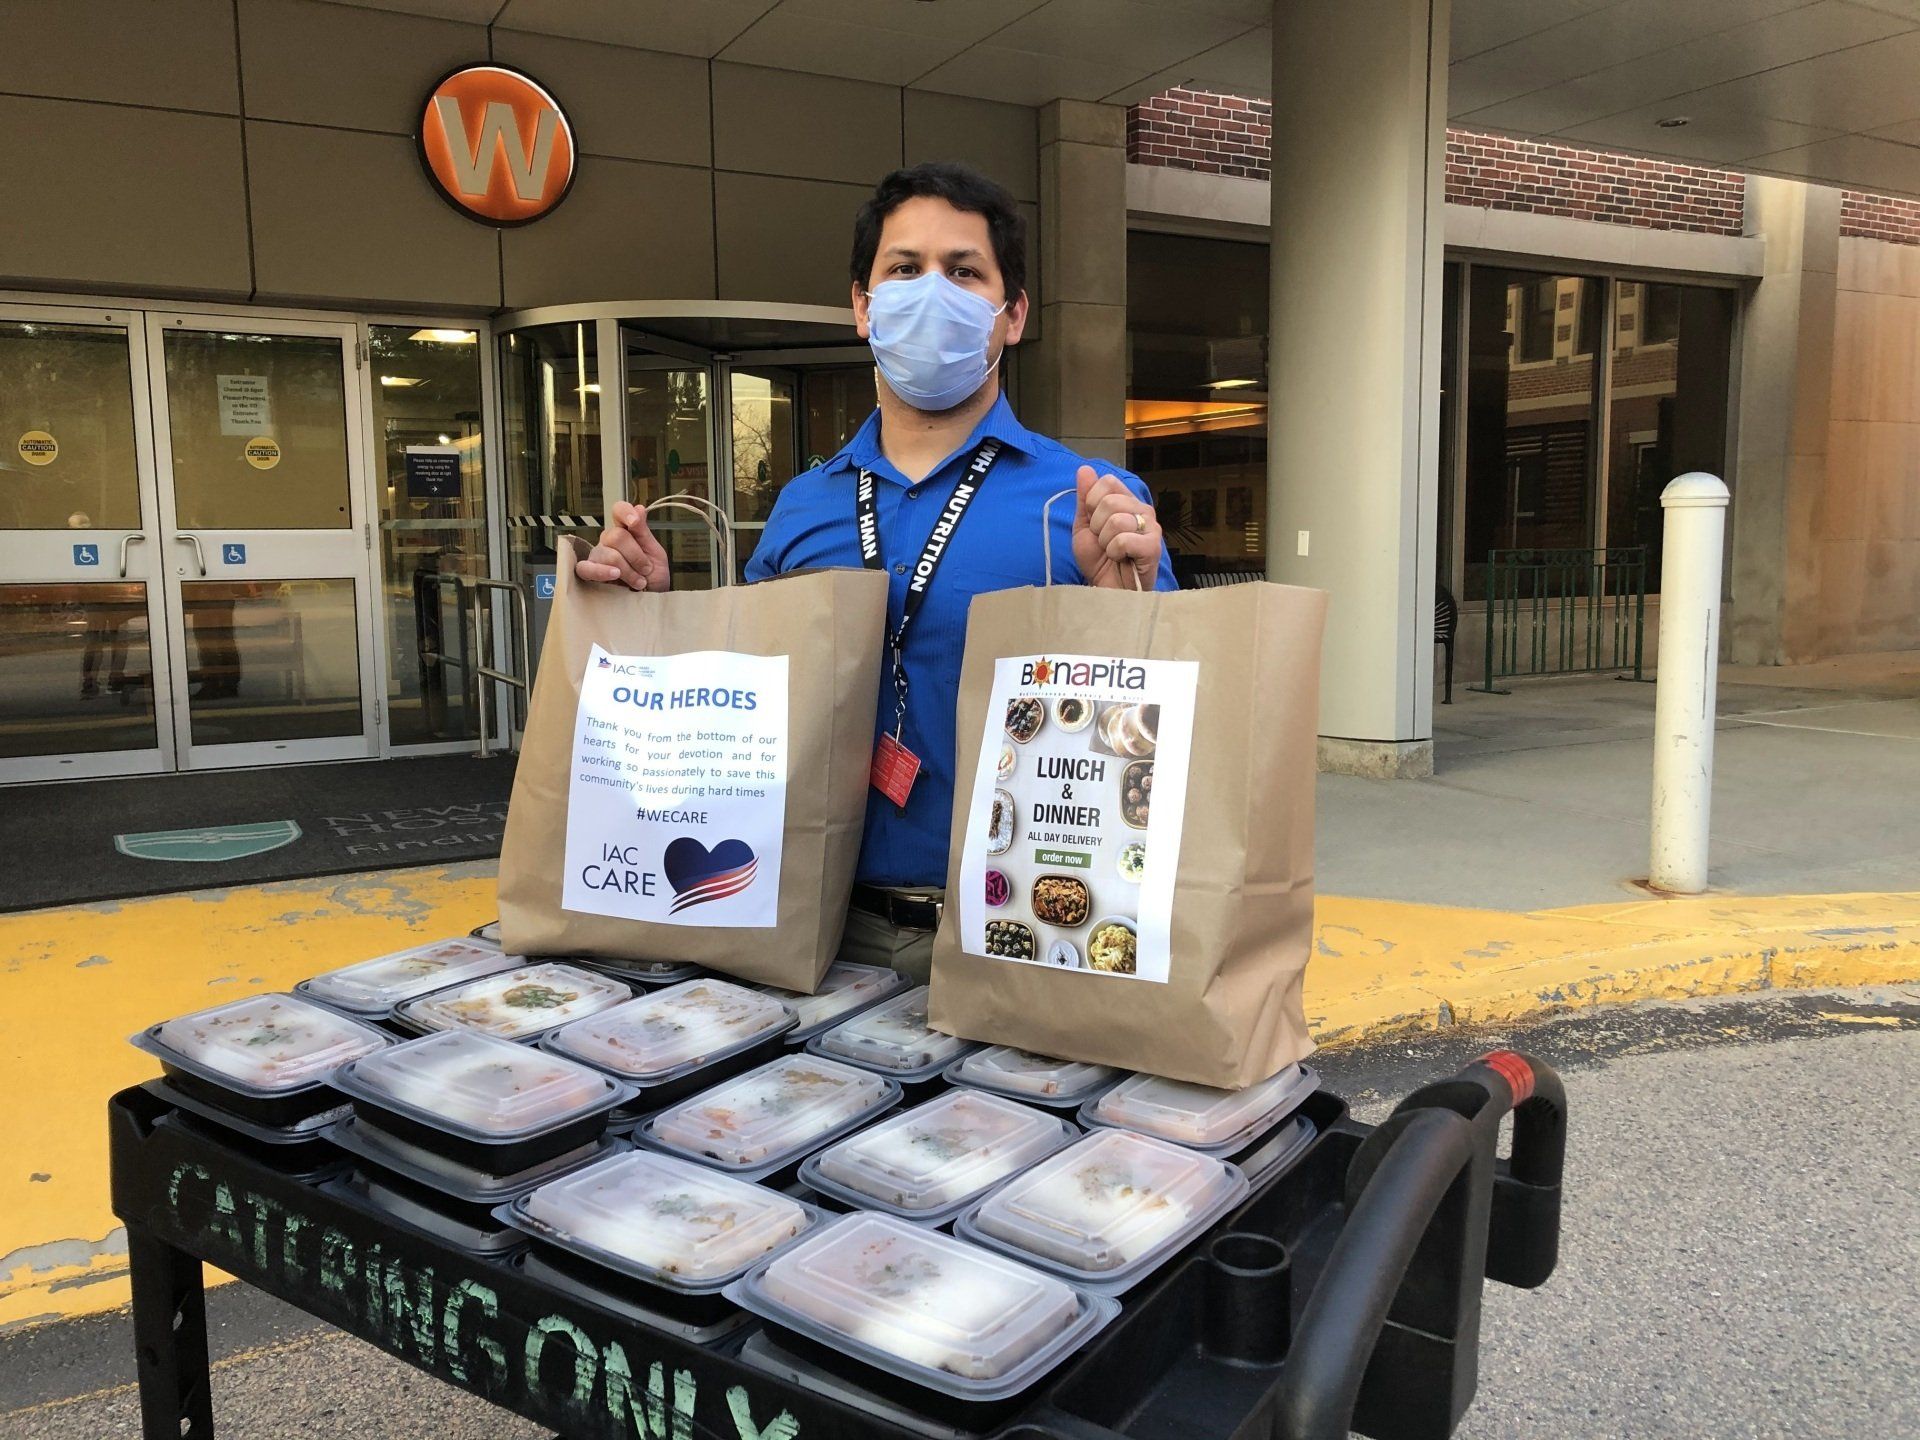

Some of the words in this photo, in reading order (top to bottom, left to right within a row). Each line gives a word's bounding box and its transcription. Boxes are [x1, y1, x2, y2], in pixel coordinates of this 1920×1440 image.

[434, 95, 560, 201] W
[859, 512, 877, 560] NWH
[910, 483, 975, 593] NUTRITION
[613, 664, 636, 676] IAC
[613, 687, 664, 711] OUR
[670, 688, 757, 711] HEROES
[587, 717, 619, 731] Thank
[624, 728, 642, 739] you
[648, 733, 672, 743] from
[677, 732, 691, 742] the
[697, 731, 736, 743] bottom
[742, 734, 753, 744] of
[759, 737, 777, 745] our
[583, 734, 616, 749] hearts
[625, 743, 639, 754] for
[647, 751, 671, 760] your
[679, 749, 723, 760] devotion
[732, 752, 752, 761] and
[761, 752, 776, 762] for
[581, 755, 622, 771] working
[626, 763, 639, 772] so
[643, 766, 705, 779] passionately
[711, 768, 722, 777] to
[727, 770, 751, 778] save
[756, 769, 775, 780] this
[1037, 757, 1105, 782] LUNCH
[580, 773, 643, 792] community's
[646, 784, 668, 794] lives
[672, 785, 705, 797] during
[708, 785, 733, 796] hard
[736, 786, 765, 798] times
[1061, 783, 1073, 800] &
[637, 807, 708, 824] #WECARE
[1033, 803, 1101, 828] DINNER
[1027, 831, 1042, 841] ALL
[1044, 832, 1061, 842] DAY
[1062, 834, 1103, 847] DELIVERY
[602, 843, 639, 866] IAC
[1042, 852, 1063, 863] order
[1065, 856, 1083, 865] now
[582, 864, 656, 897] CARE
[168, 1161, 508, 1390] CATERING
